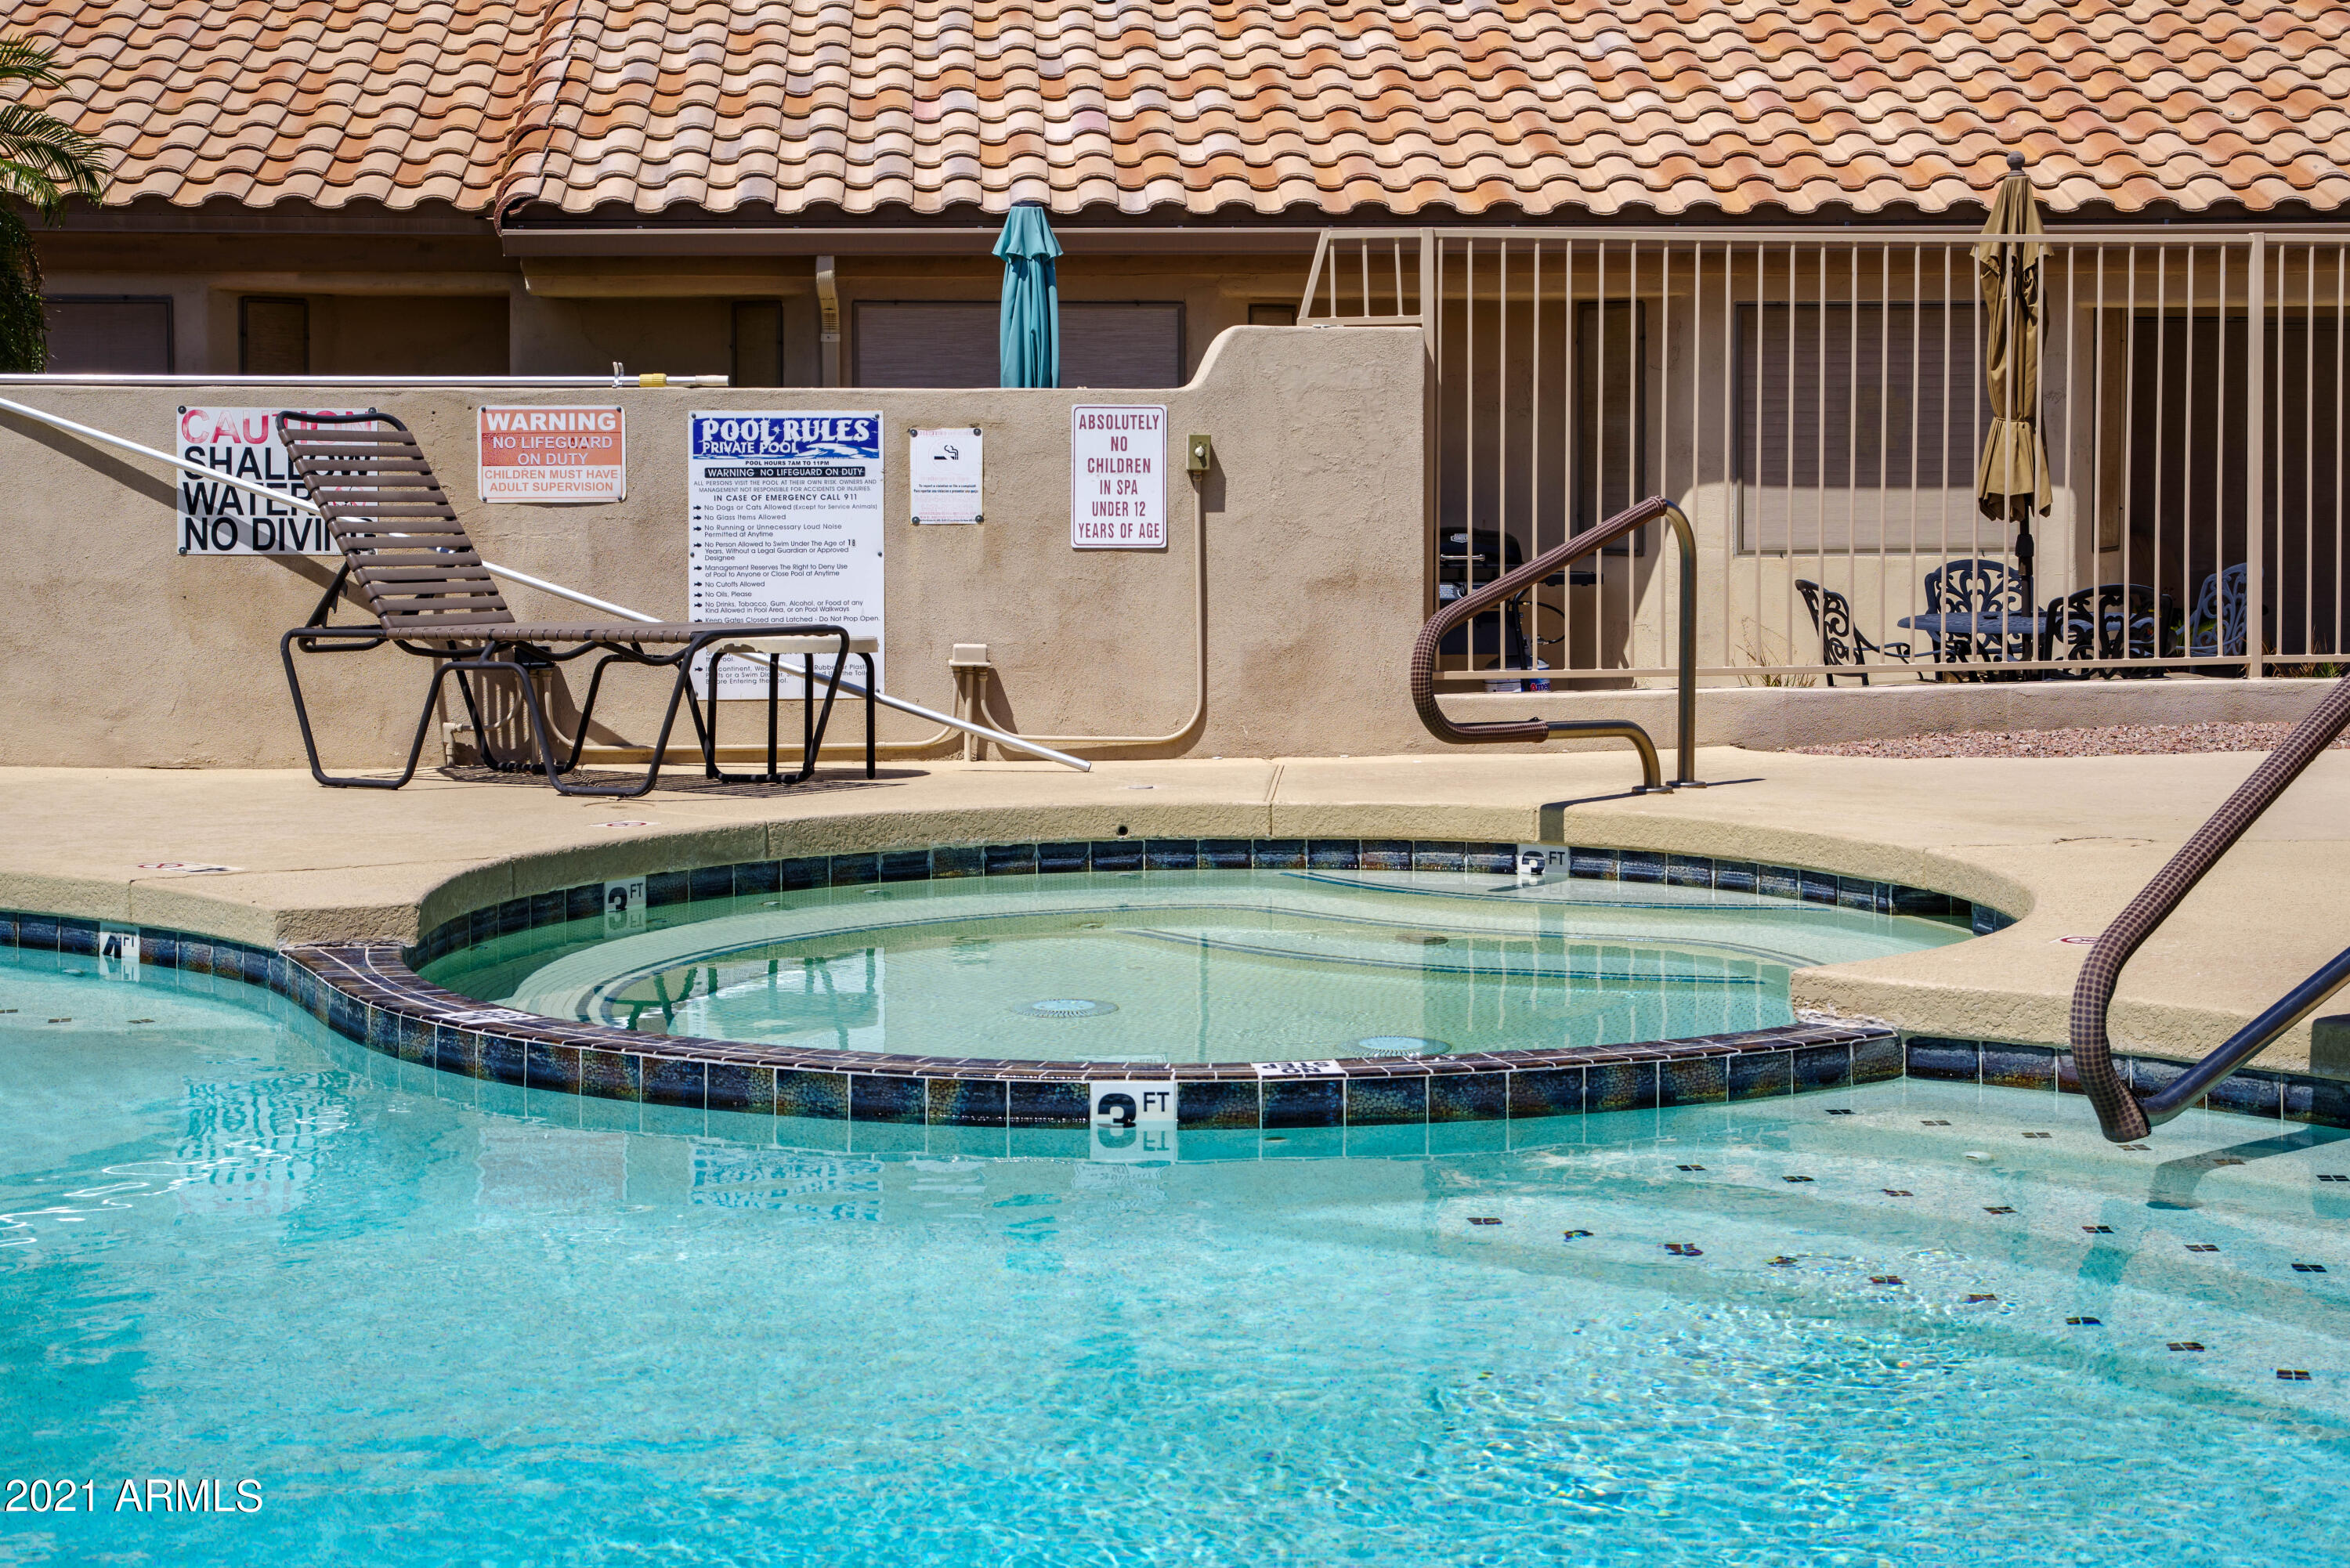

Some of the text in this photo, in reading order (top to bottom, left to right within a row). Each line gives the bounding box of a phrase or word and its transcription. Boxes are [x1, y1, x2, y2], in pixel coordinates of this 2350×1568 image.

[486, 413, 616, 431] WARNING
[1079, 414, 1159, 430] ABSOLUTELY
[702, 418, 870, 443] POOL RULES
[493, 436, 613, 449] NO LIFEGUARD
[702, 440, 798, 453] PRIVATE POOL
[1111, 436, 1128, 451] NO
[518, 453, 588, 465] ON DUTY
[1087, 458, 1151, 473] CHILDREN
[484, 469, 618, 479] CHILDREN MUST HAVE
[490, 482, 613, 491] ADULT SUPERVISION
[1100, 480, 1138, 495] IN SPA
[1092, 501, 1146, 516] UNDER 12
[185, 517, 376, 551] NO DIVI
[1079, 523, 1159, 538] YEARS OF AGE
[1522, 851, 1565, 875] 3 FT
[608, 883, 643, 912] 3 FT
[1098, 1092, 1170, 1128] 3 FT
